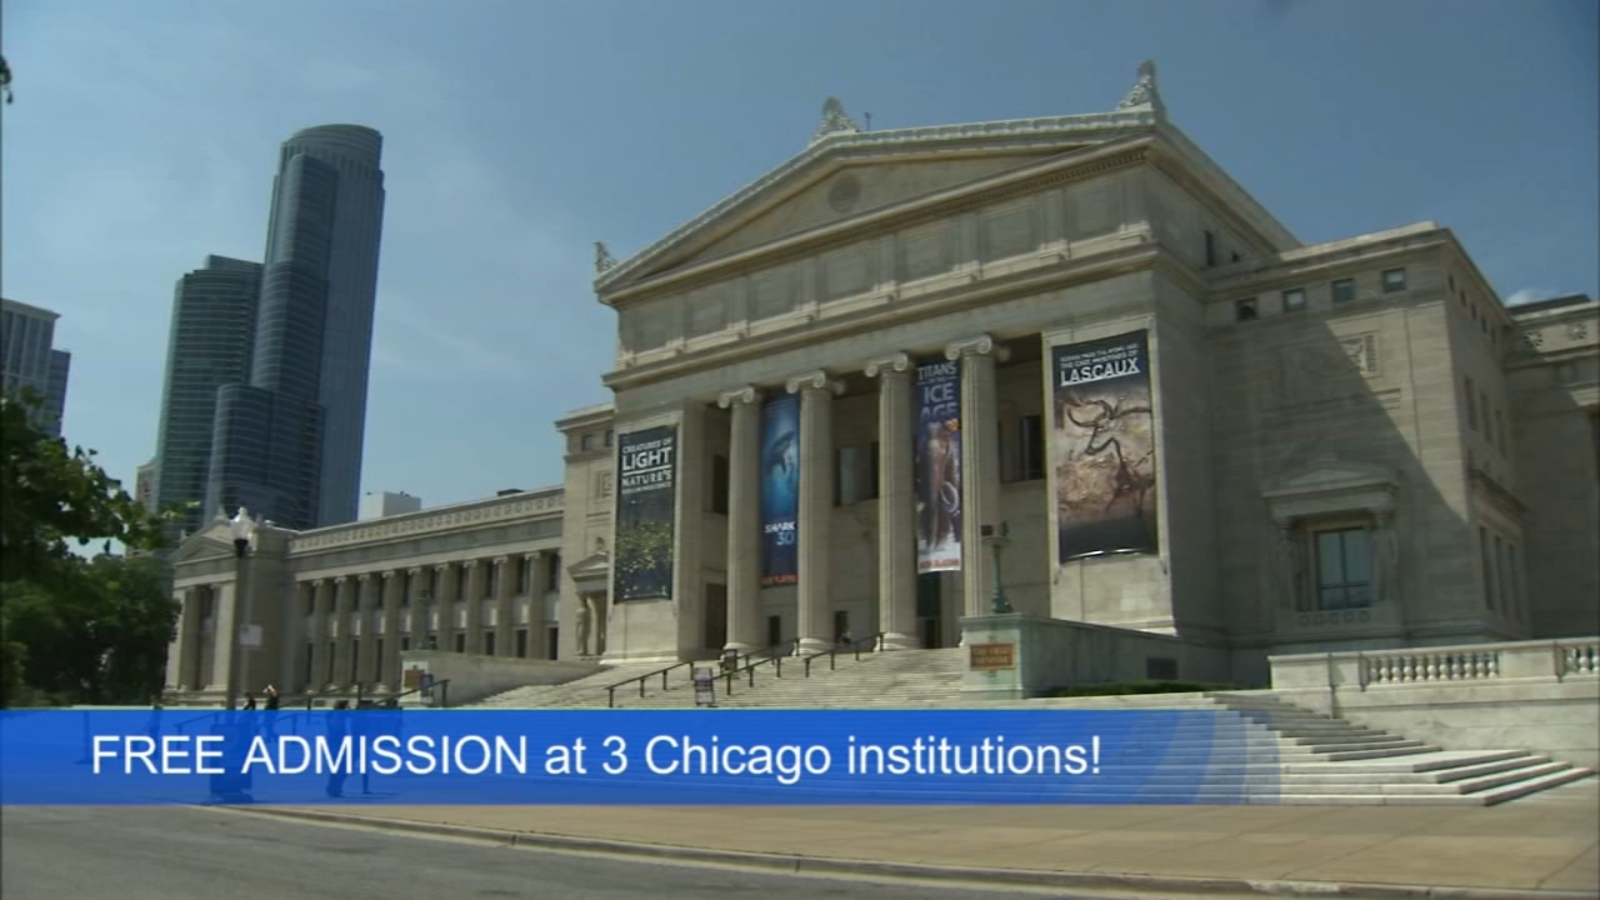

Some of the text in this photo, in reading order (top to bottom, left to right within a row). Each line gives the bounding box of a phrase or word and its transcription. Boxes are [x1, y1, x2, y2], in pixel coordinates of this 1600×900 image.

[917, 360, 957, 381] TITANS
[1060, 357, 1140, 386] LASCAUX
[924, 382, 954, 404] ICE
[920, 401, 958, 419] AGE
[622, 446, 673, 471] LIGHT
[764, 521, 796, 533] SHARK
[776, 530, 795, 546] 3D
